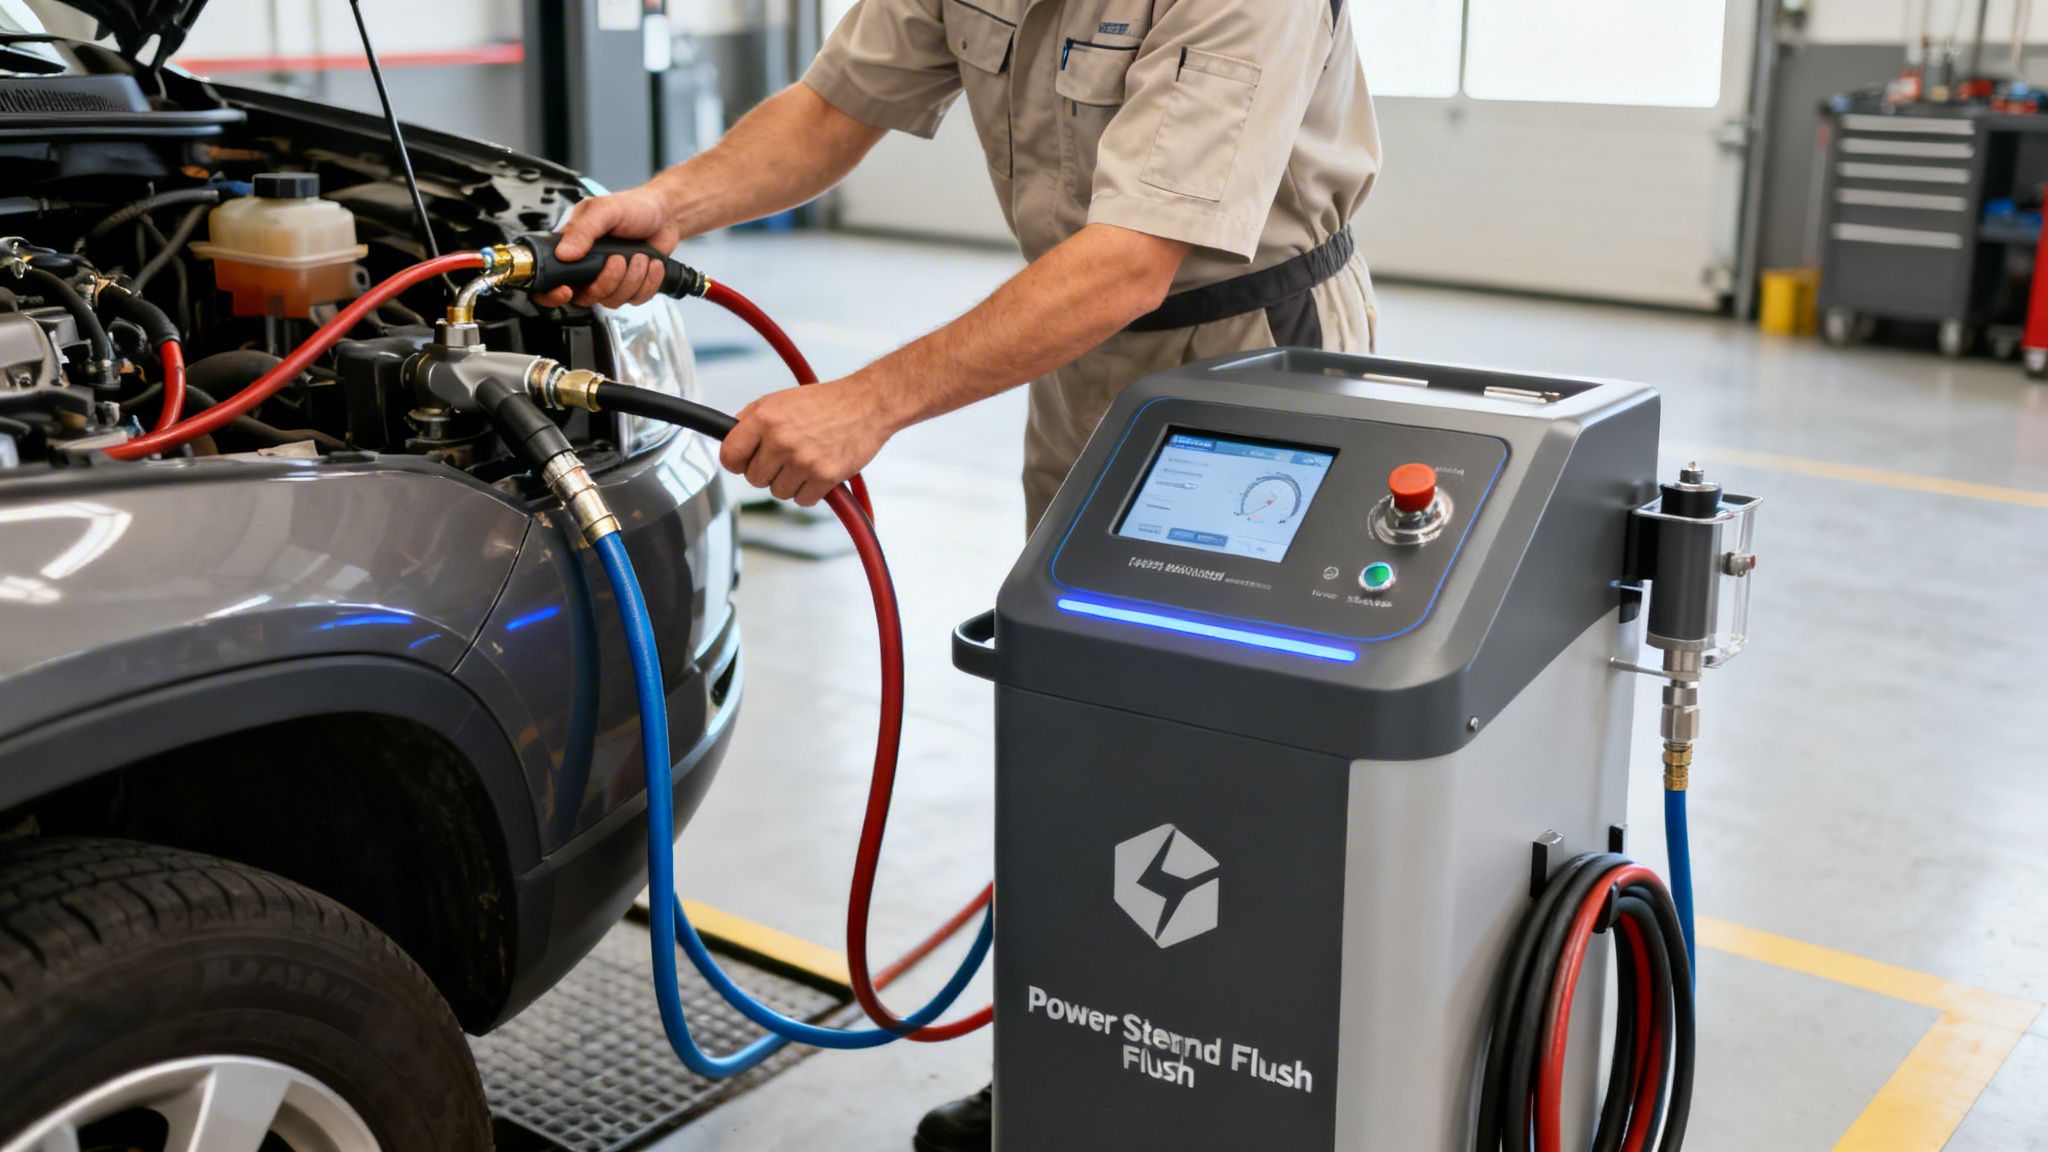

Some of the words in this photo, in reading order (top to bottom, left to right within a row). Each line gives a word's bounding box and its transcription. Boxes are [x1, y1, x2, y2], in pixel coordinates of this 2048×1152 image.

[1028, 985, 1118, 1035] Power
[1231, 1042, 1313, 1093] Flush
[1122, 1044, 1195, 1088] Flush
